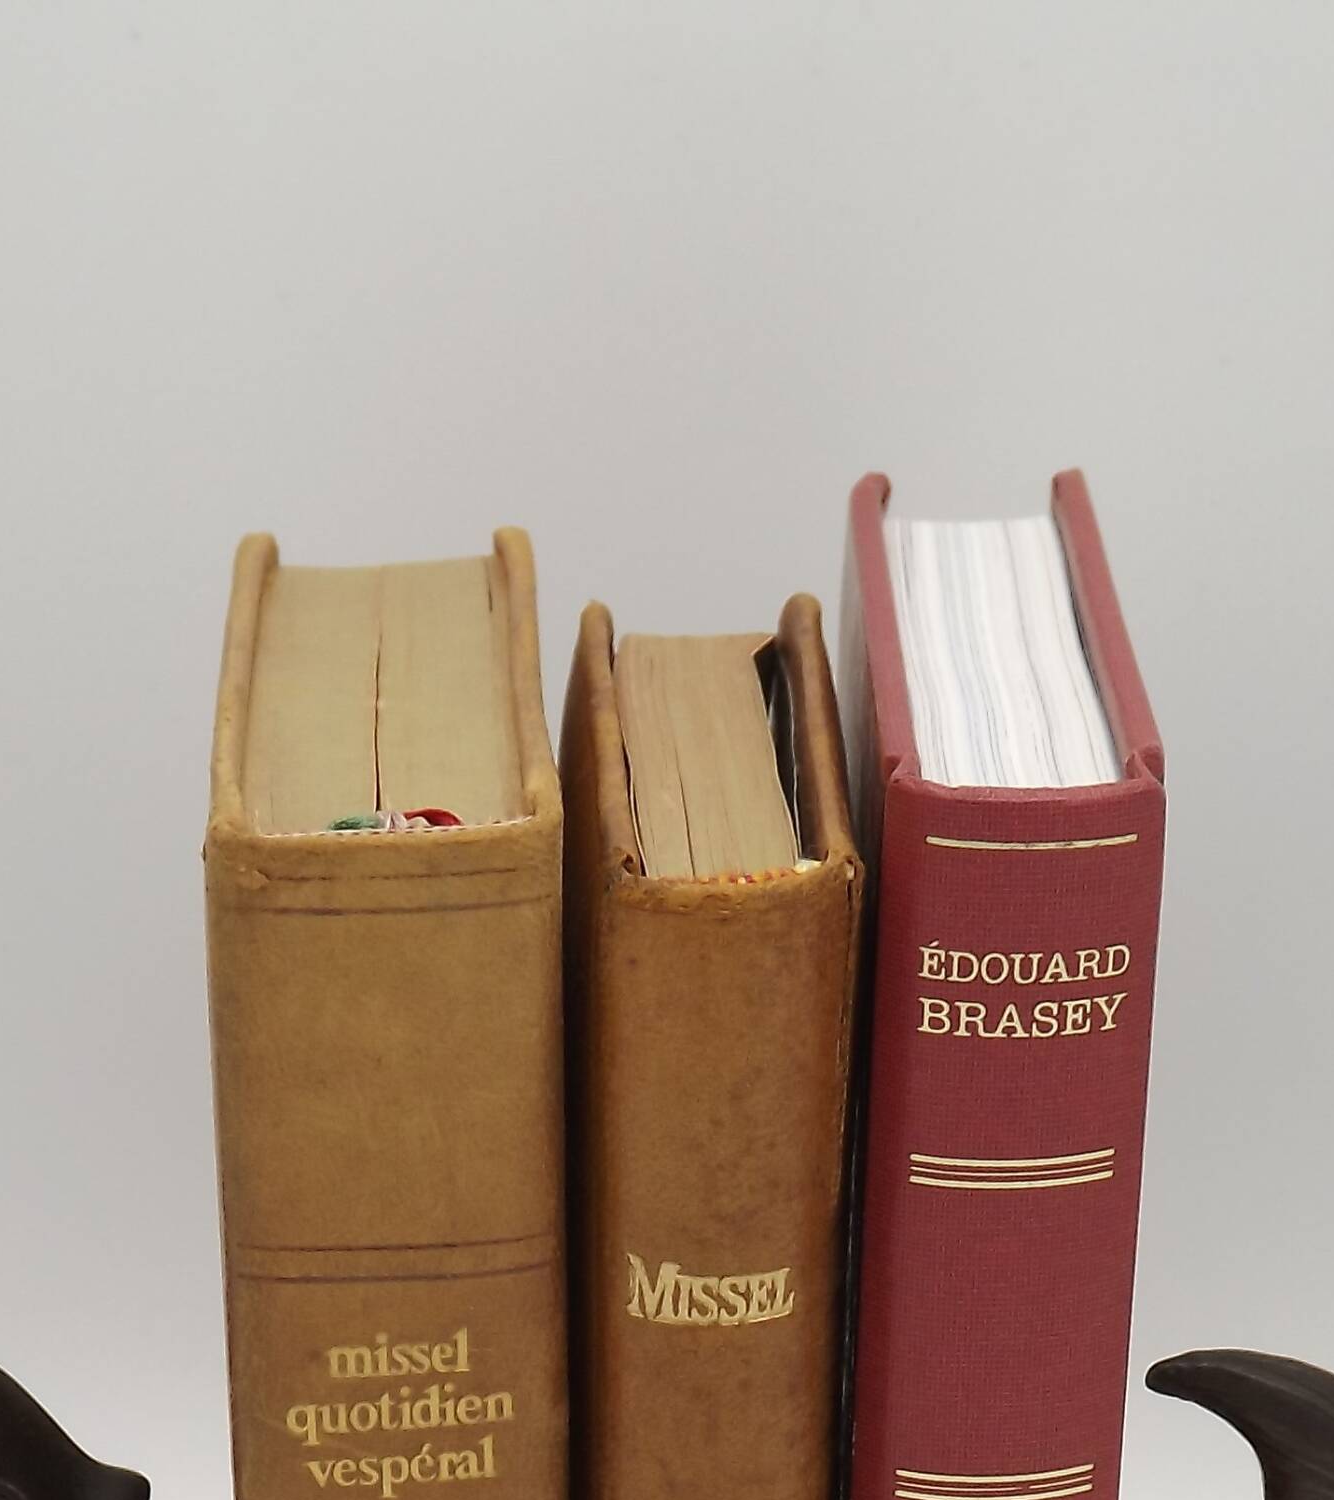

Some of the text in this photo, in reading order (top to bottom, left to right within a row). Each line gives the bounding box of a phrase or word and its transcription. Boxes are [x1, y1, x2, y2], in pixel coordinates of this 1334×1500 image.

[917, 939, 1131, 985] ÉDOUARD
[916, 992, 1128, 1039] BRASEY
[327, 1327, 471, 1379] missel
[285, 1382, 515, 1447] quotidien
[306, 1436, 498, 1499] vespéral
